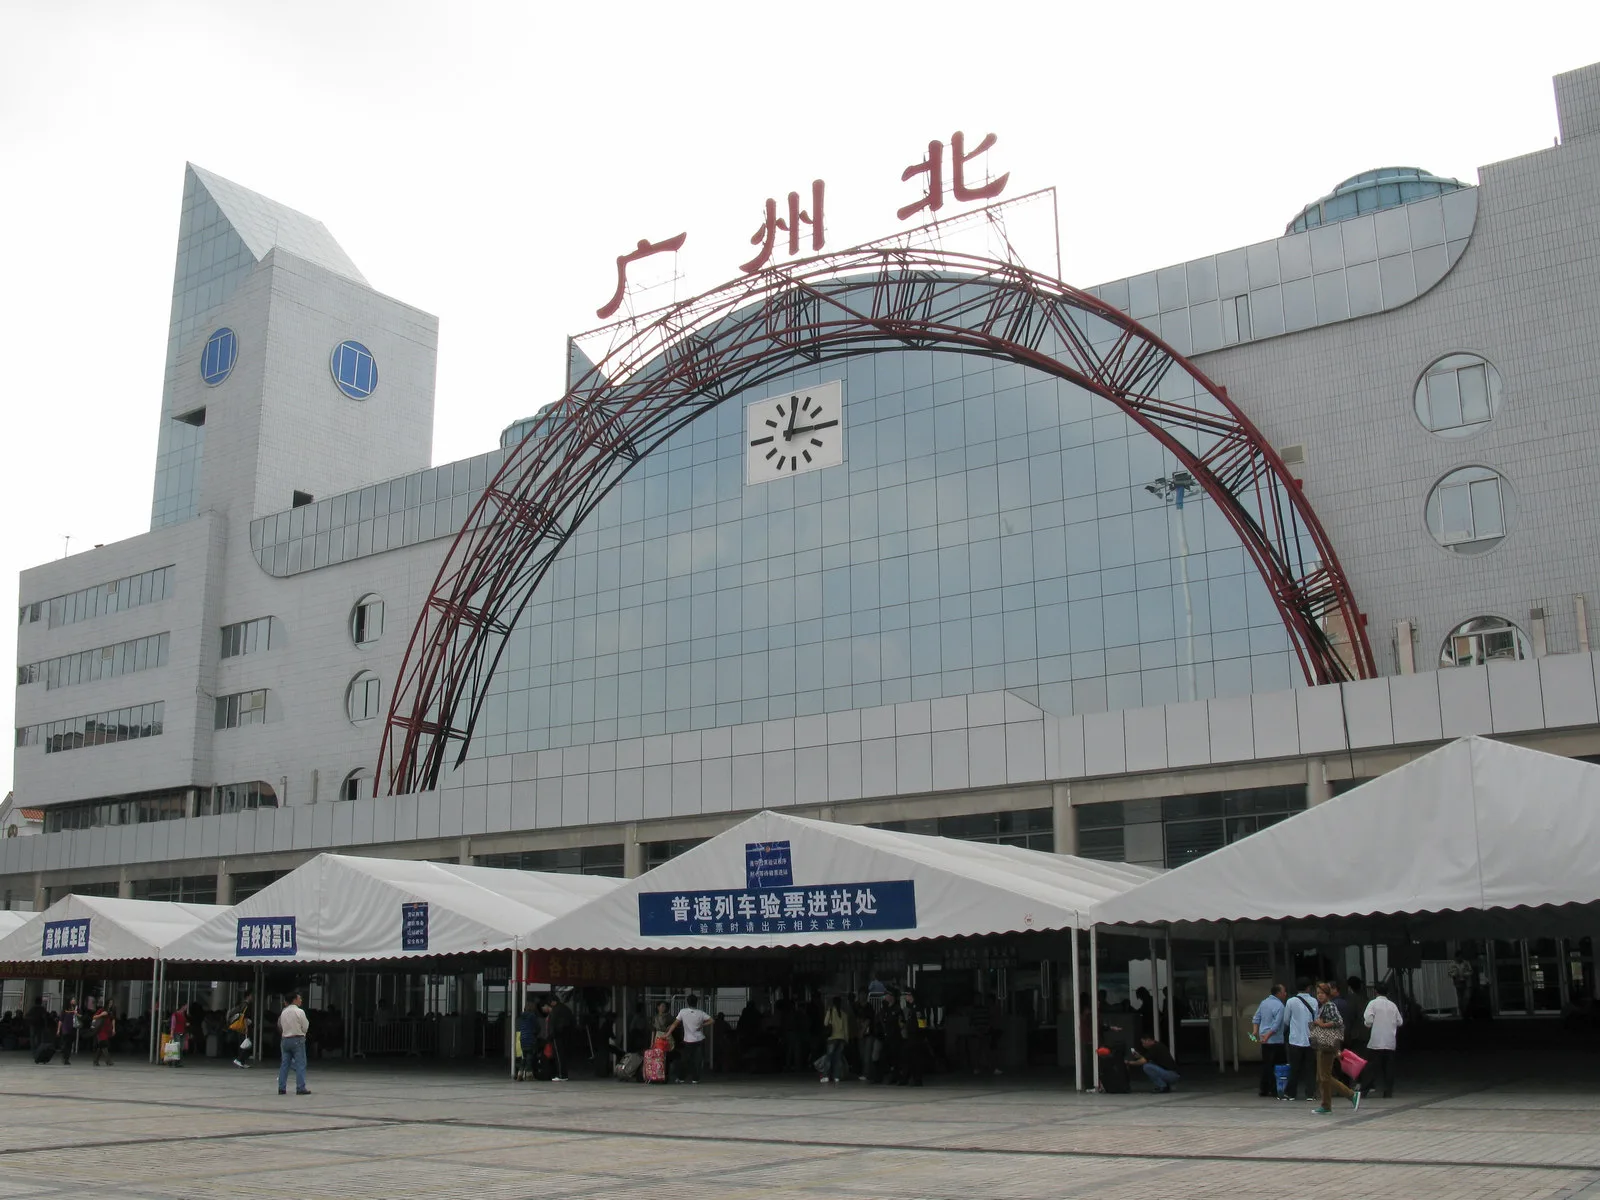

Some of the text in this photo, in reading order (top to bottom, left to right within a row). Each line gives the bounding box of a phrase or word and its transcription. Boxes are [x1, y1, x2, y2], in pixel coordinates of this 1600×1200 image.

[596, 130, 1010, 319] 广州北
[671, 888, 878, 922] 普速列车验票进站处
[45, 925, 87, 950] 高铁候车区
[240, 924, 292, 949] 高铁检票口
